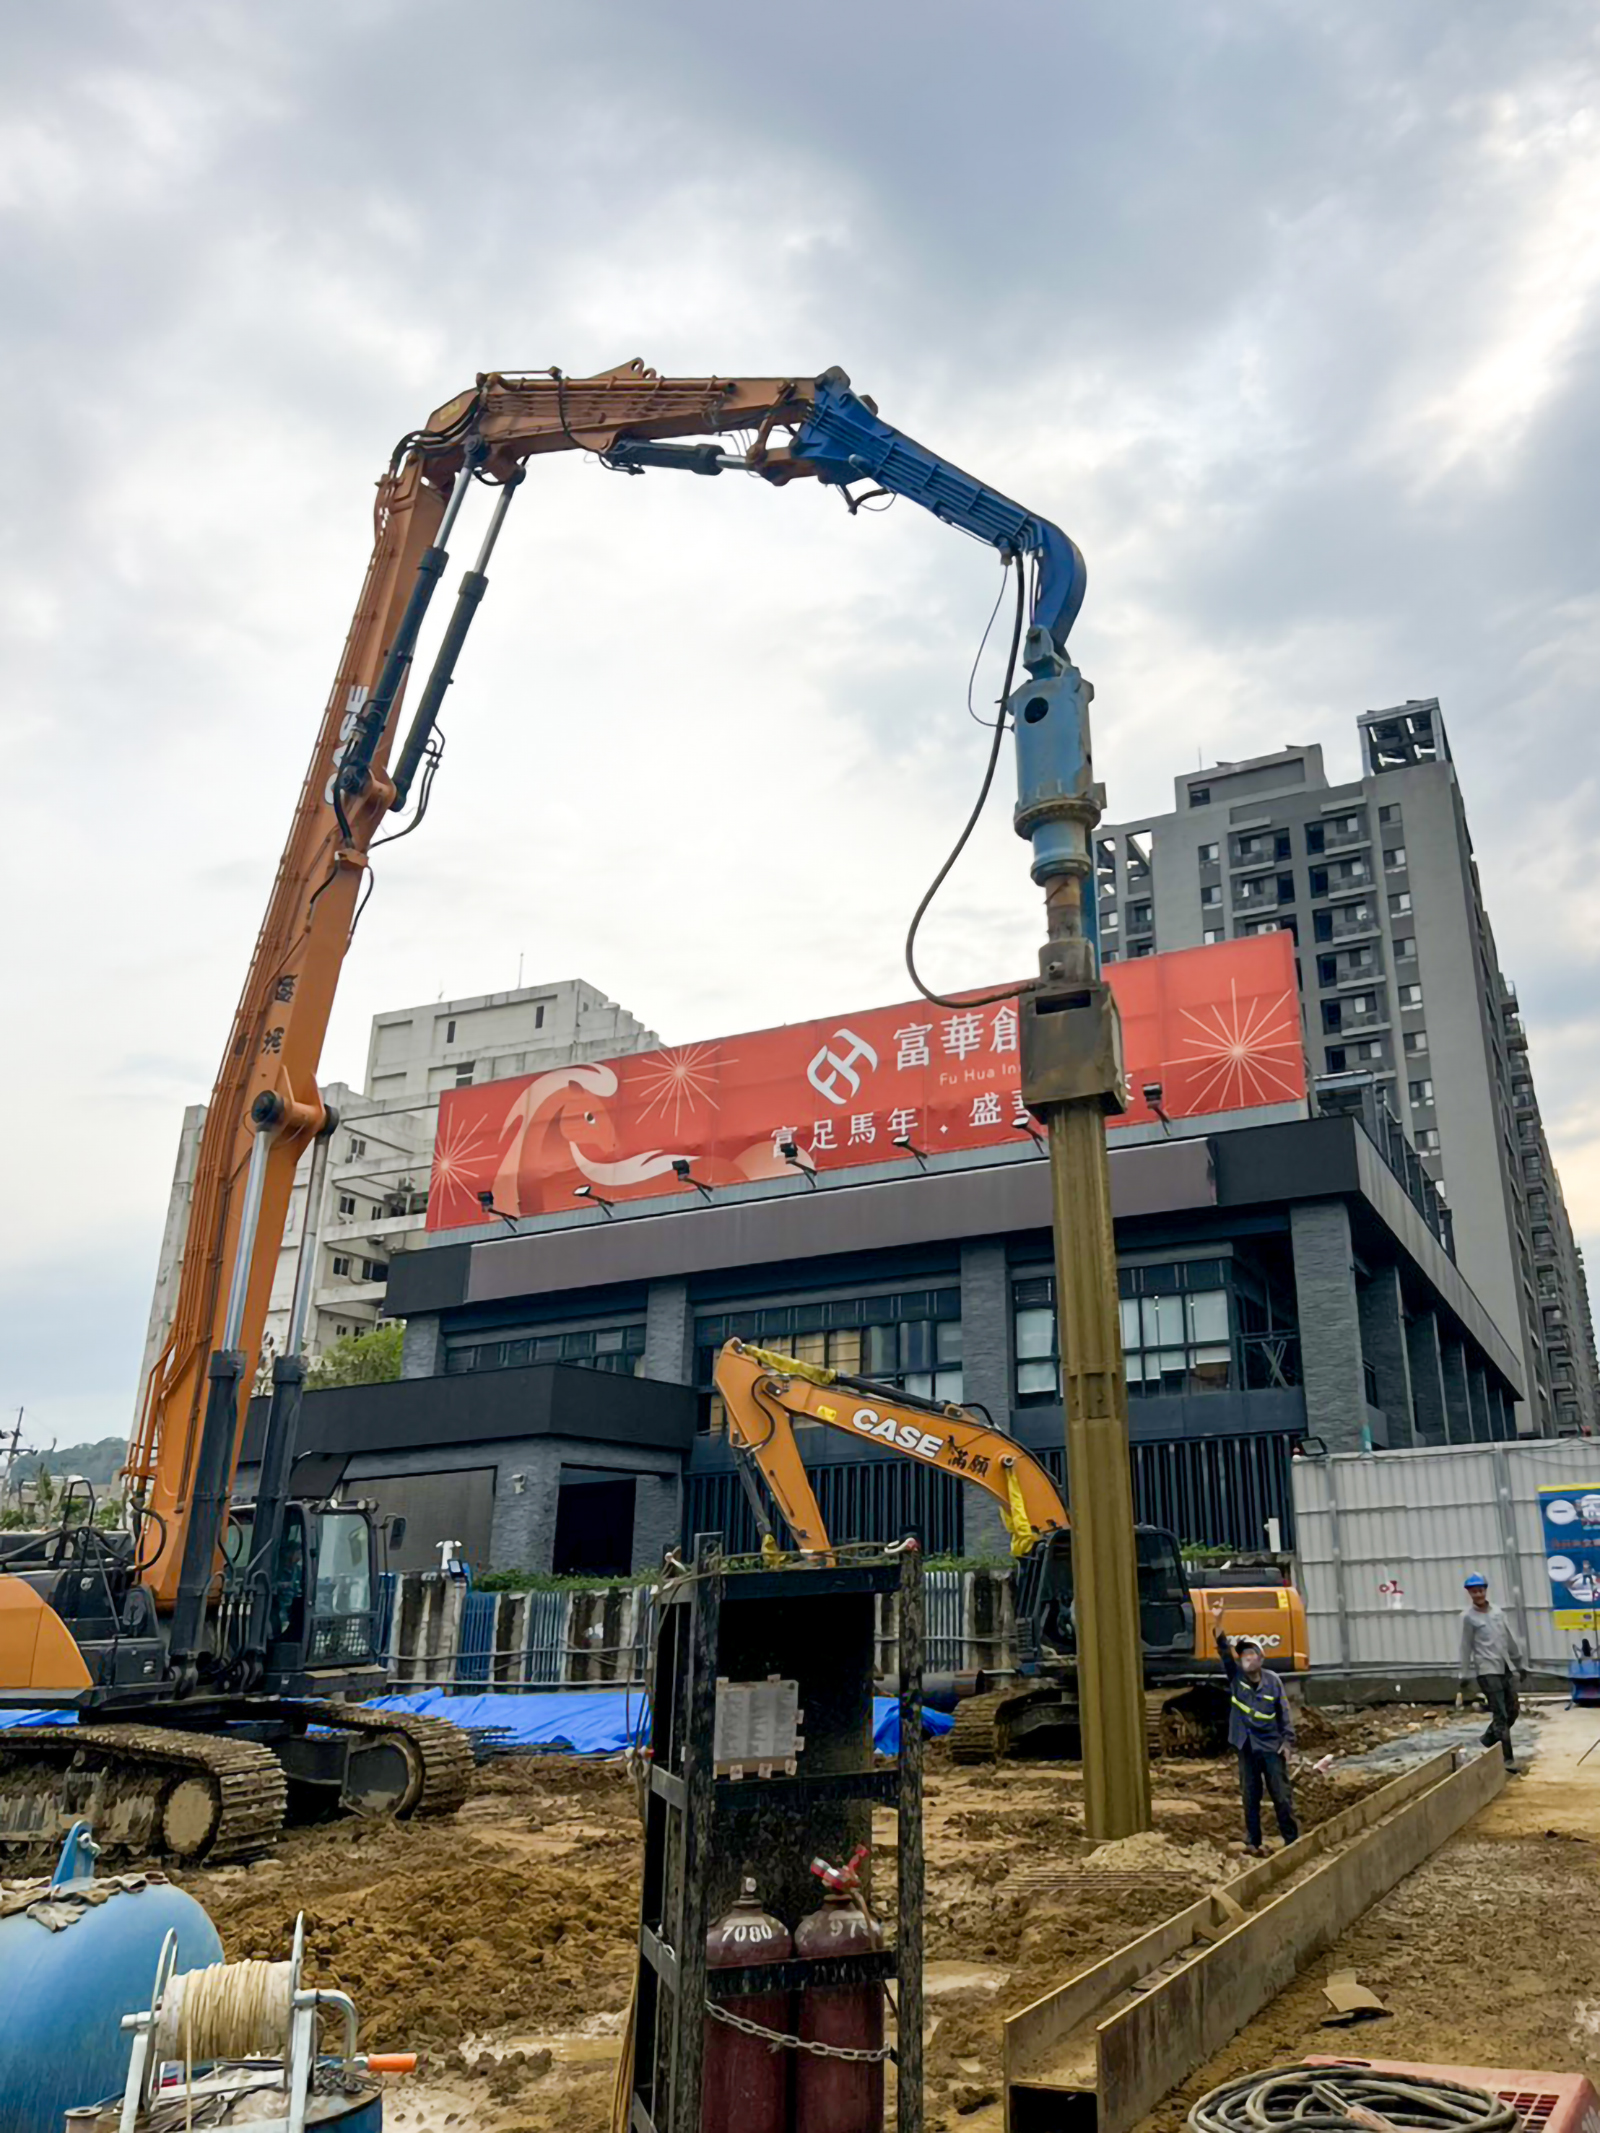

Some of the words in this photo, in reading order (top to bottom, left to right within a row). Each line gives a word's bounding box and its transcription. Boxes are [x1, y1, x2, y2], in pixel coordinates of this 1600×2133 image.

[938, 1072, 958, 1086] Fu
[964, 1068, 995, 1083] Hua
[1002, 1063, 1021, 1075] In
[770, 1107, 919, 1158] 富足馬年
[852, 1408, 943, 1458] CASE
[721, 1924, 773, 1943] 7080
